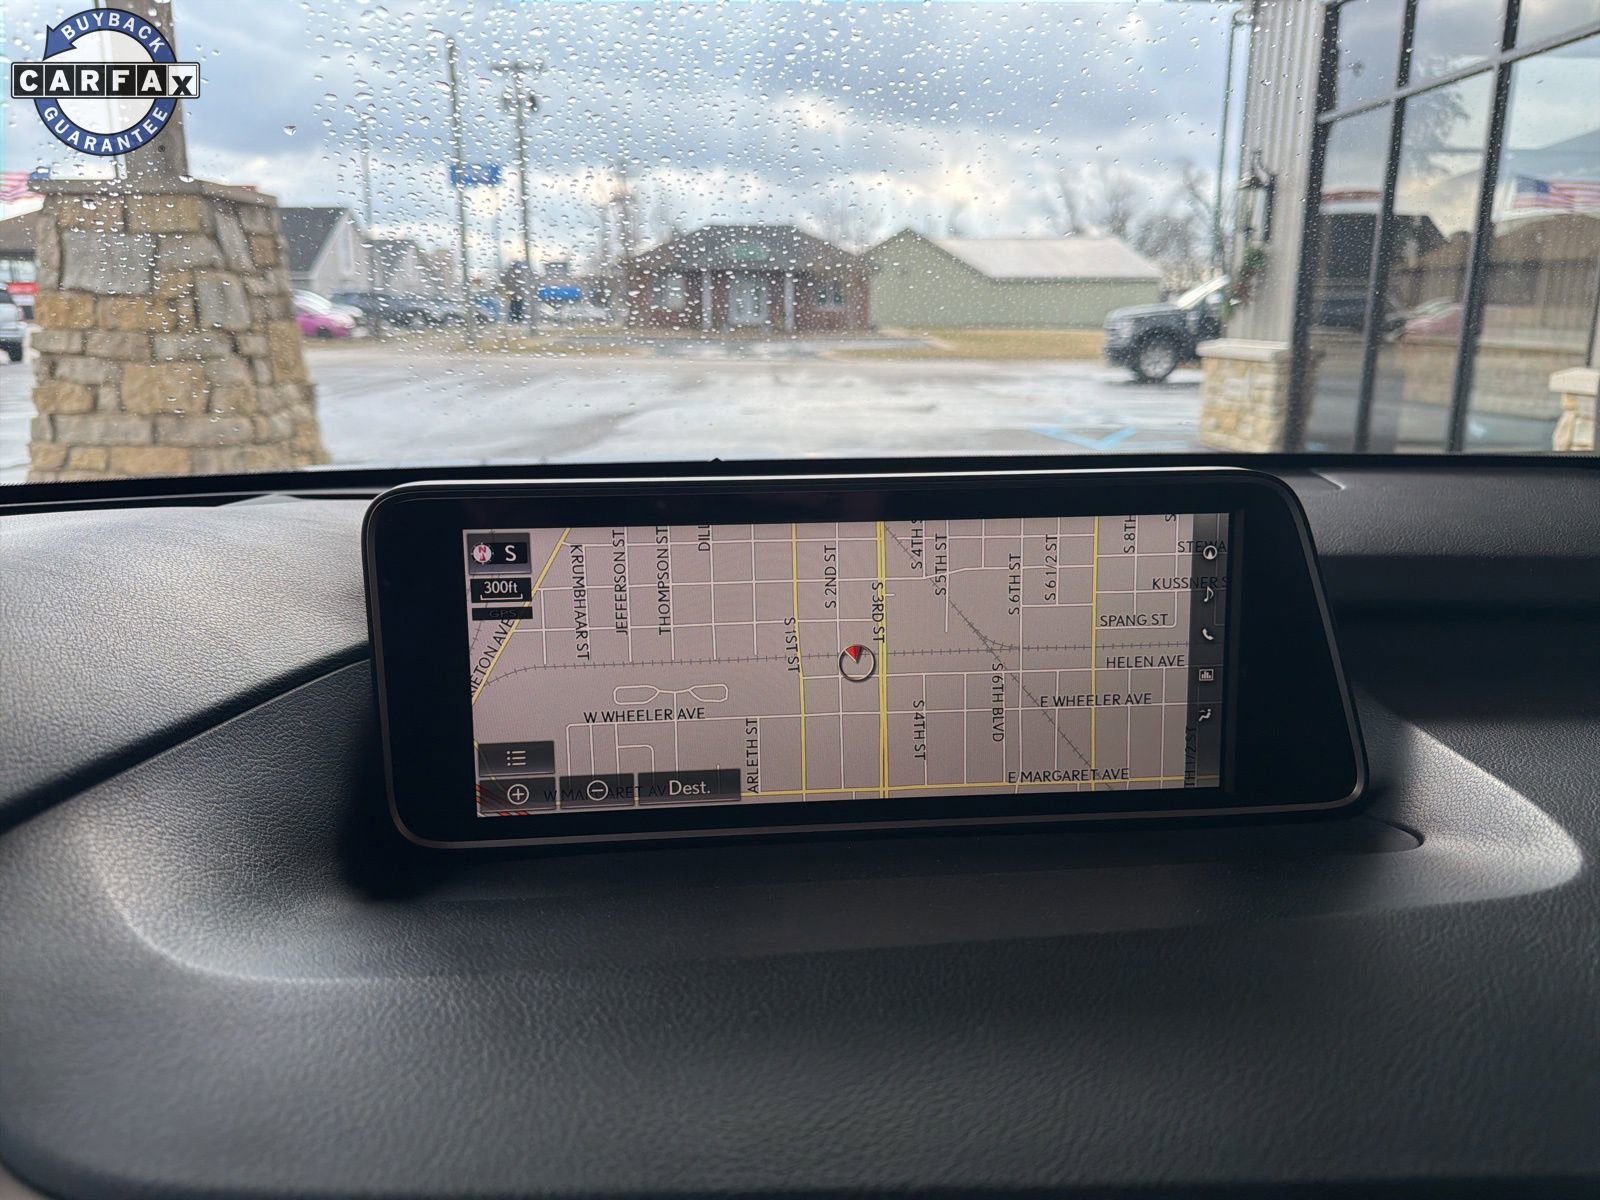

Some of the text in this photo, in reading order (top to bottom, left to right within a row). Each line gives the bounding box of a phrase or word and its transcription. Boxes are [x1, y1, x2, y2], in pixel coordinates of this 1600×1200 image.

[911, 528, 924, 557] 4TH
[1046, 534, 1058, 551] ST
[1123, 545, 1136, 553] S
[504, 544, 517, 562] S
[911, 561, 922, 570] S
[935, 534, 948, 596] S 5TH ST
[612, 529, 628, 636] JEFFERSON ST
[656, 526, 671, 636] THOMPSON ST
[824, 545, 836, 608] S 2ND ST
[1008, 553, 1021, 615] S 6TH ST
[1152, 576, 1218, 590] KUSSNER
[484, 580, 518, 594] 300ft
[1045, 592, 1056, 600] S
[570, 544, 590, 660] KRUMBHAAR ST
[489, 609, 517, 618] GPS
[872, 582, 885, 644] S 3RD ST
[1100, 614, 1168, 627] SPANG ST
[492, 618, 516, 646] AVE
[784, 617, 800, 672] S 1ST ST
[1106, 655, 1186, 668] HELEN AVE
[992, 663, 1004, 742] S 6TH BLVD
[1040, 693, 1152, 707] E WHEELER AVE
[584, 708, 705, 724] W WHEELER AVE
[913, 700, 926, 760] S 4TH ST
[746, 718, 759, 794] ARLETH ST
[1008, 768, 1130, 784] E MARGARET AVE
[669, 780, 711, 796] Dest.
